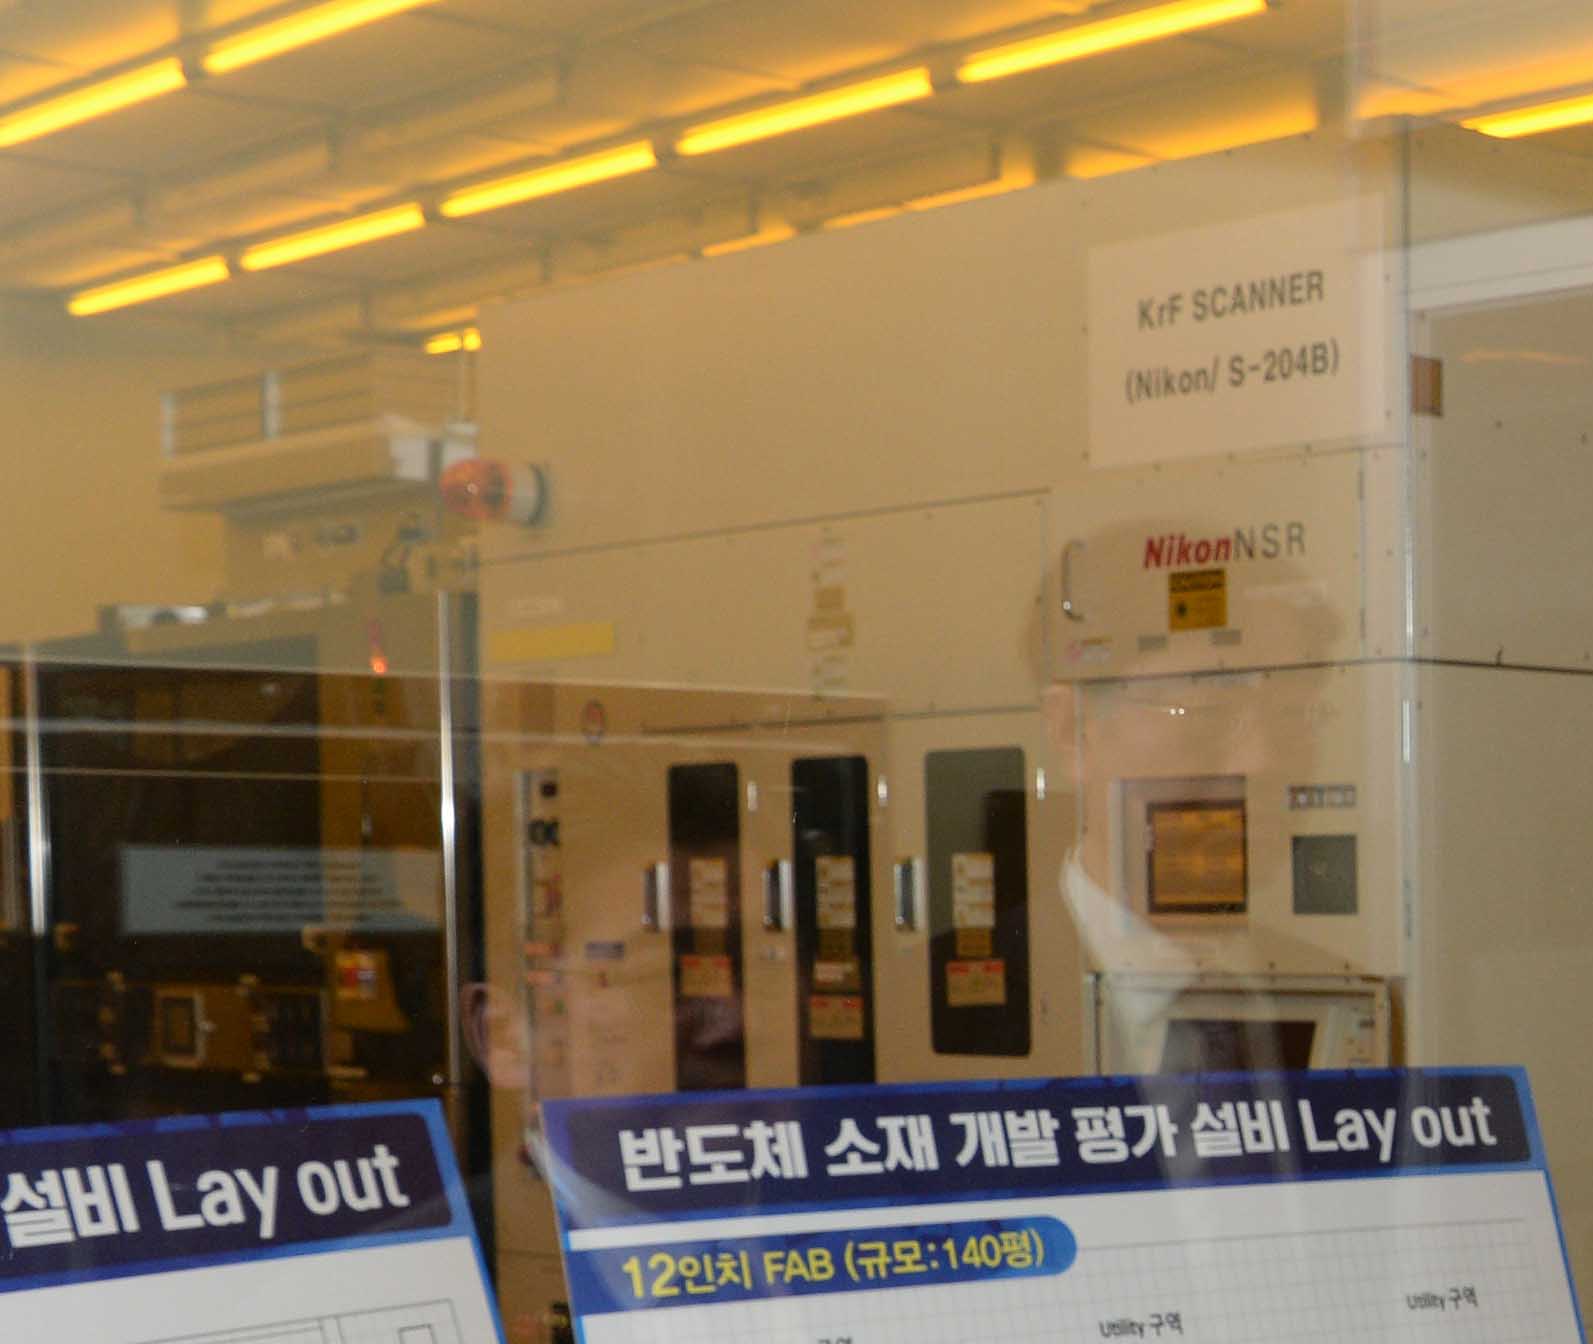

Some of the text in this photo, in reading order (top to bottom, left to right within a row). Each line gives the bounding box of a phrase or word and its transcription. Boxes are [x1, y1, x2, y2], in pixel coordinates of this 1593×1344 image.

[1138, 270, 1326, 331] KrF SCANNER
[1125, 338, 1340, 404] (Nikon/ S-204B)
[1143, 522, 1307, 569] Nikon NSR
[617, 1096, 1498, 1193] 반도체 소재 개발 평가 설비 Lay out
[1, 1145, 410, 1249] 설비 Lay out
[622, 1227, 1045, 1300] 12인치 FAB (규모:140평)
[1149, 1312, 1184, 1335] 구역
